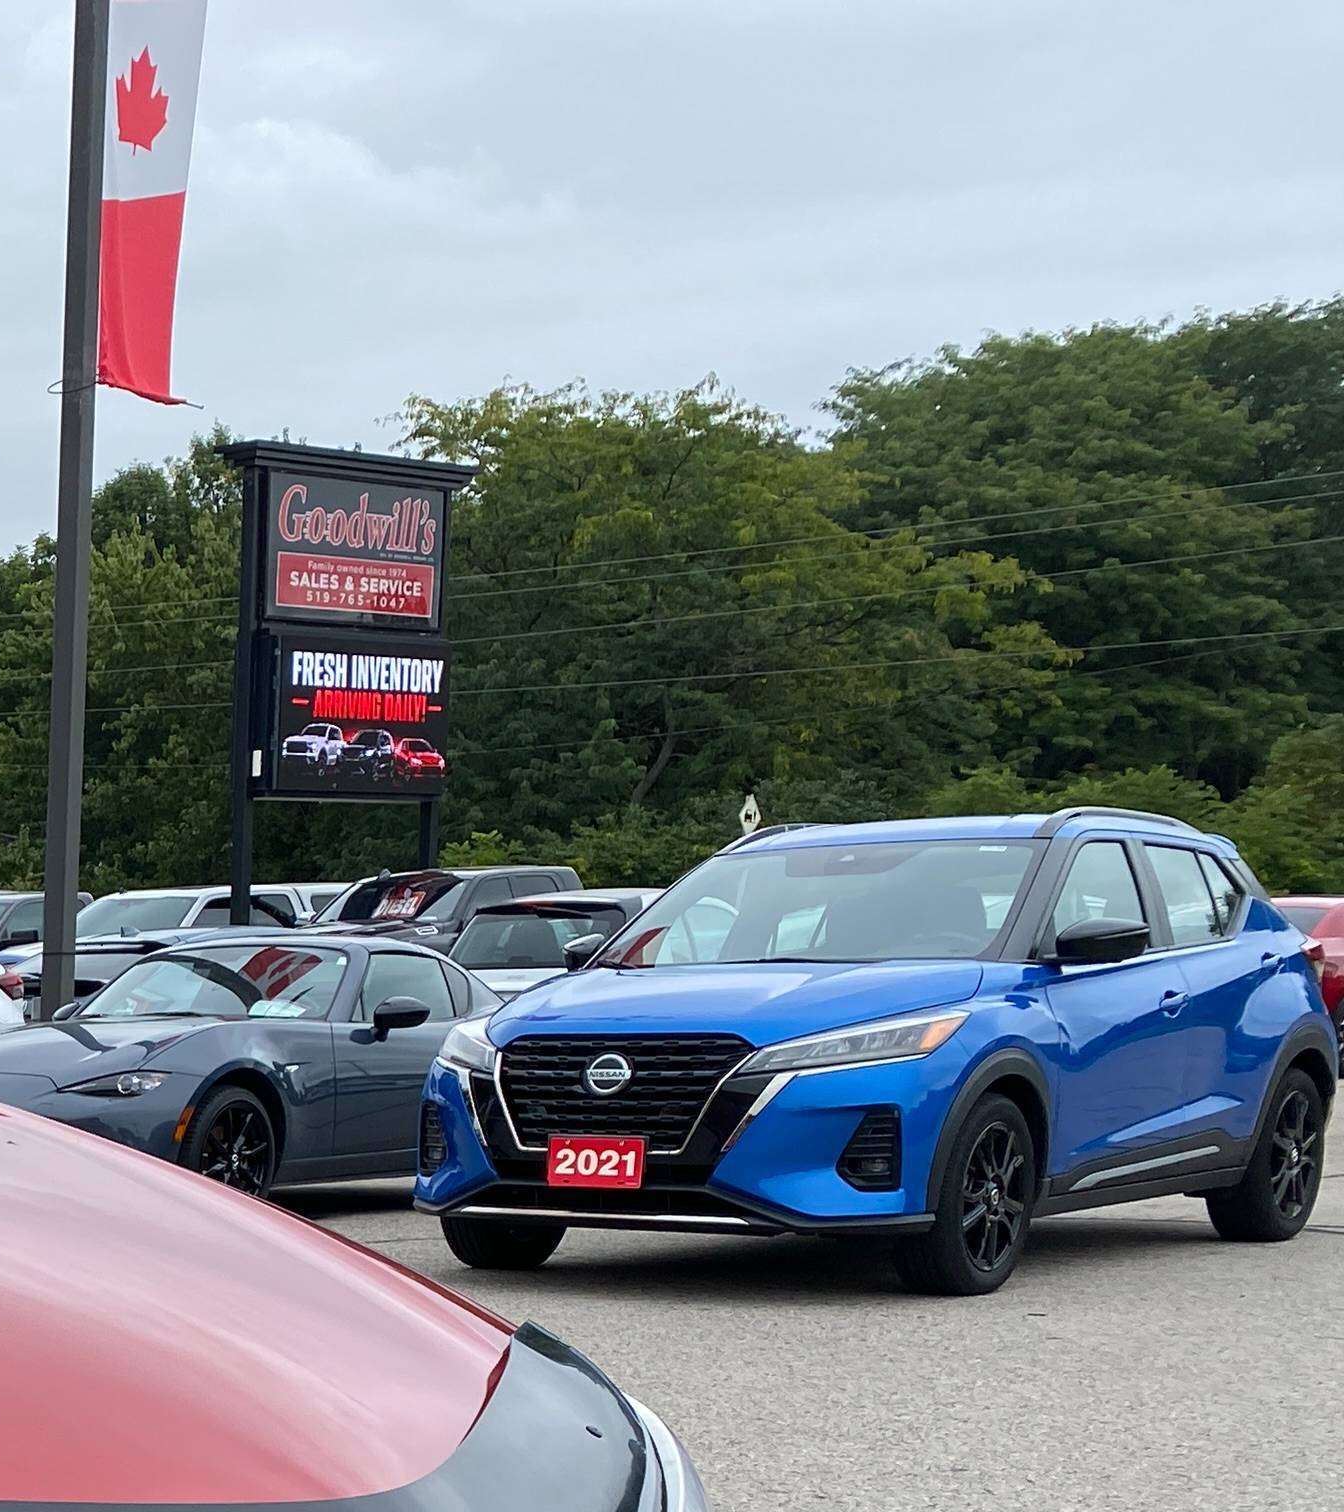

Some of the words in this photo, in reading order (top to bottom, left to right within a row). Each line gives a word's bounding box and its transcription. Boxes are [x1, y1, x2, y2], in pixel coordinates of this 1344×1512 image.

[278, 484, 437, 555] Goodwill's
[308, 560, 334, 573] Family
[336, 565, 365, 575] owned
[366, 565, 387, 576] since
[289, 571, 339, 590] SALES
[344, 576, 354, 591] &
[360, 577, 422, 597] SERVICE
[306, 590, 406, 609] 519-765-1047
[292, 651, 348, 688] FRESH
[351, 655, 444, 694] INVENTORY
[313, 689, 382, 719] ARRIVING
[384, 694, 427, 722] DAILY!
[554, 1148, 636, 1177] 2021
